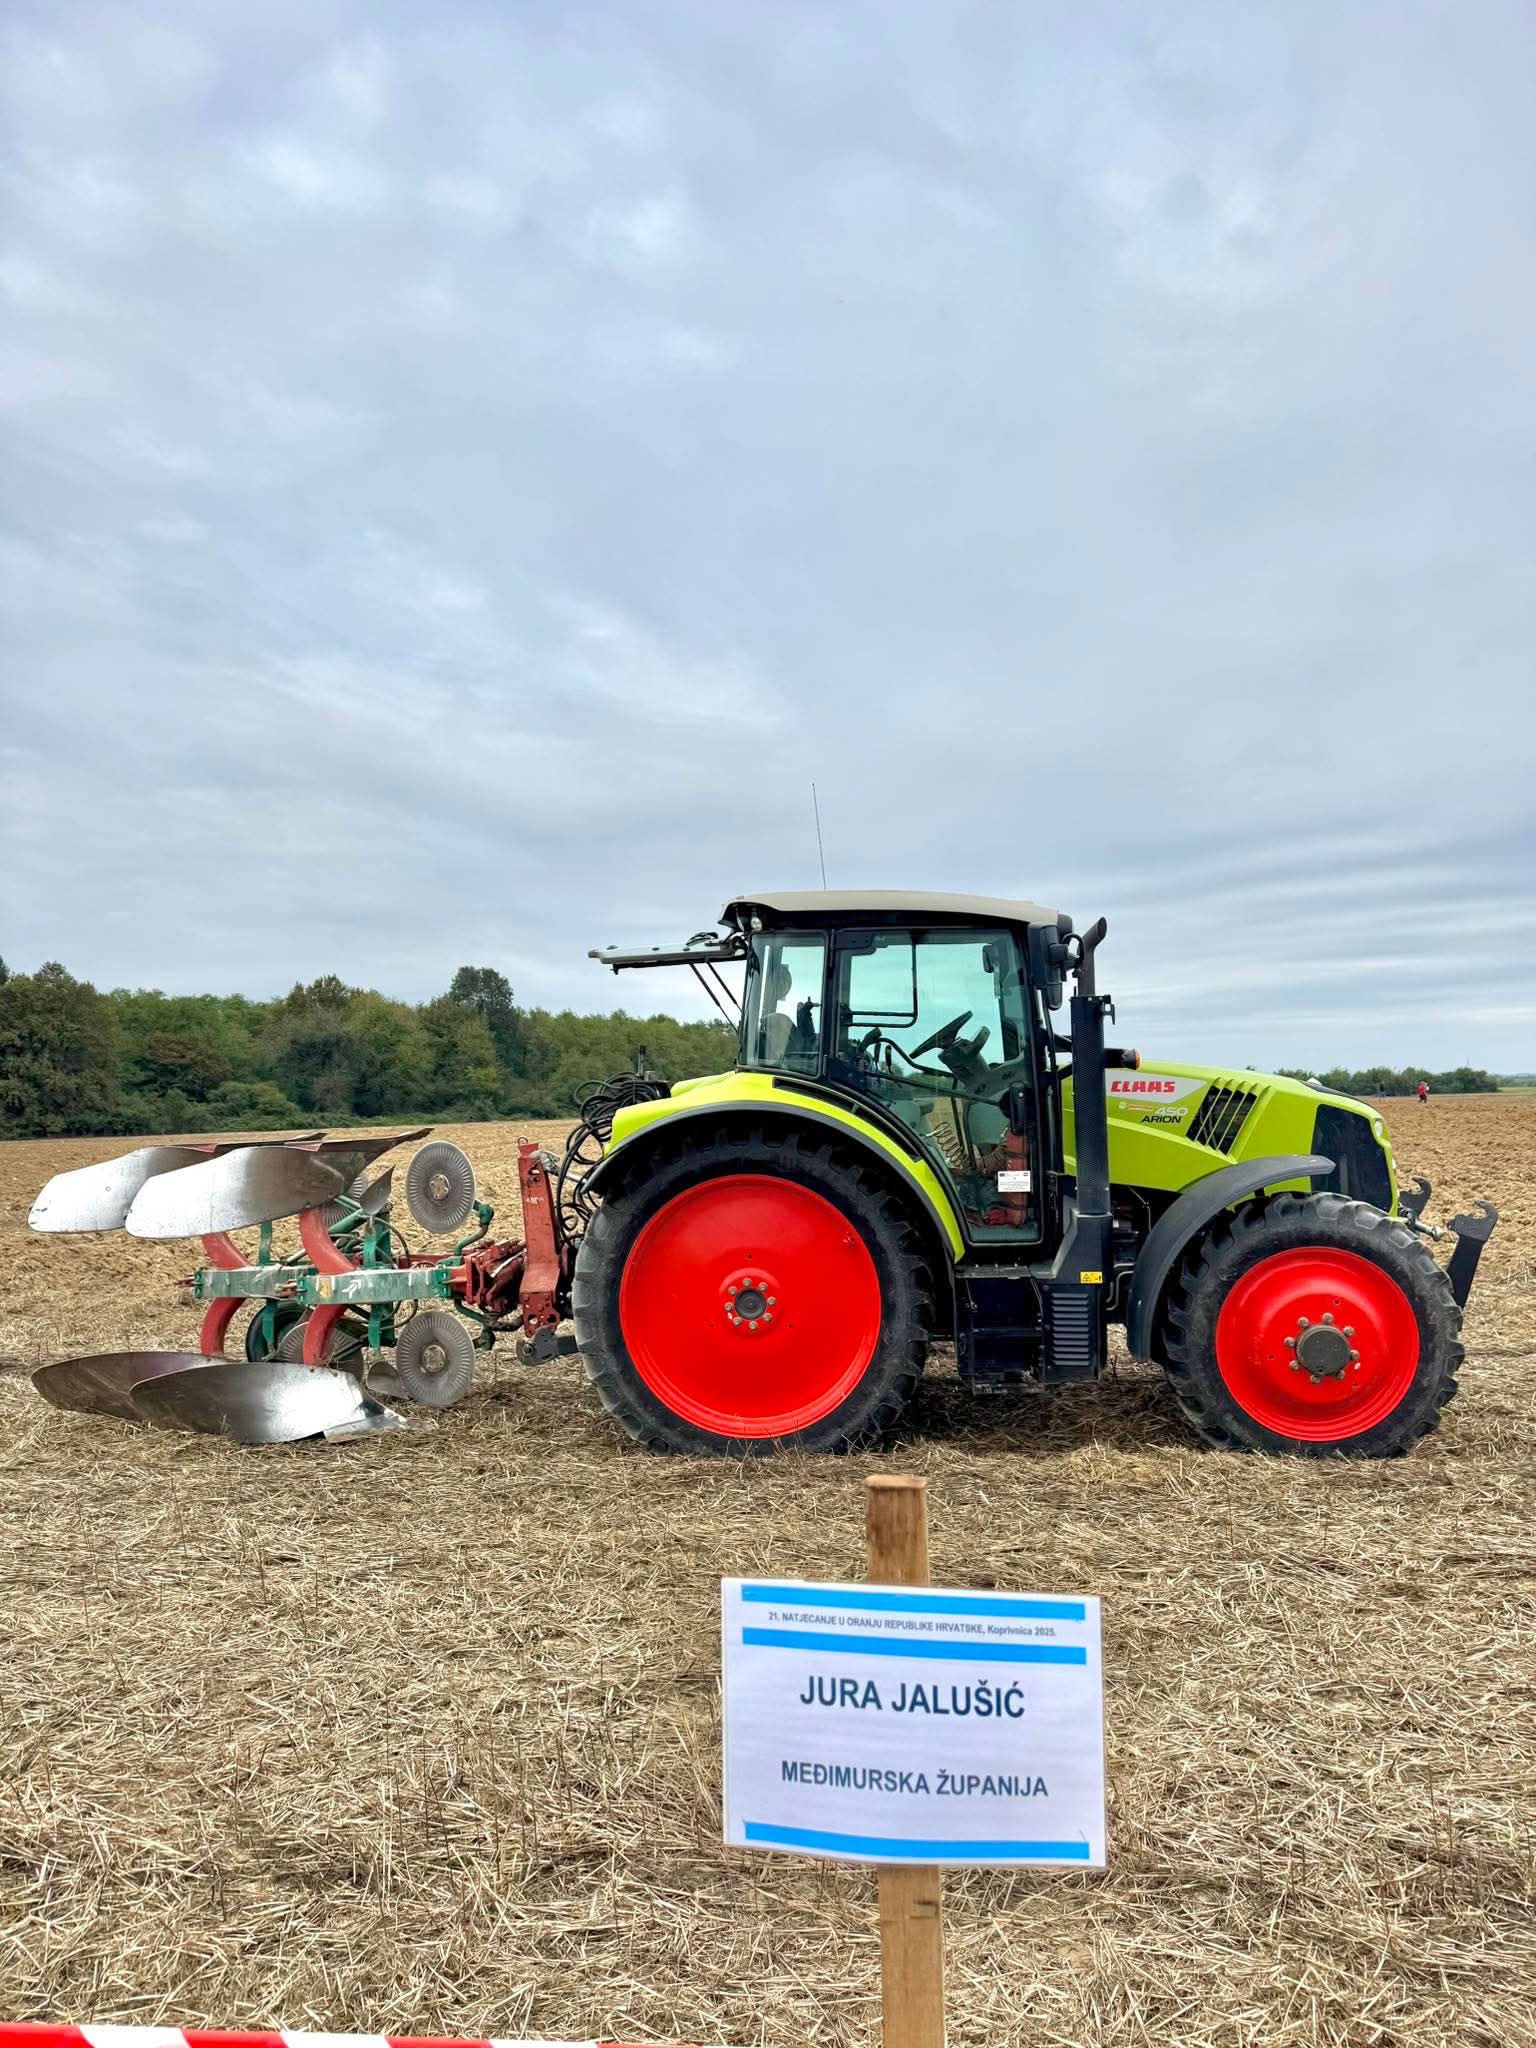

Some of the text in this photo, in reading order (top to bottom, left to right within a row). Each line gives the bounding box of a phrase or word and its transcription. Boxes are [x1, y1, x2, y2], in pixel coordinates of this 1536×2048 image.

[1111, 1081, 1175, 1093] CLAAS
[1141, 1115, 1182, 1124] ARION
[1156, 1107, 1188, 1116] 450
[768, 1611, 1057, 1637] 21. NATJECANJE U ORANJU REPUBLIKE HRVATSKE, Koprivnica 2025.
[800, 1675, 1026, 1719] JURA JALUŠIĆ
[781, 1760, 1049, 1797] MEĐIMURSKA ŽUPANIJA
